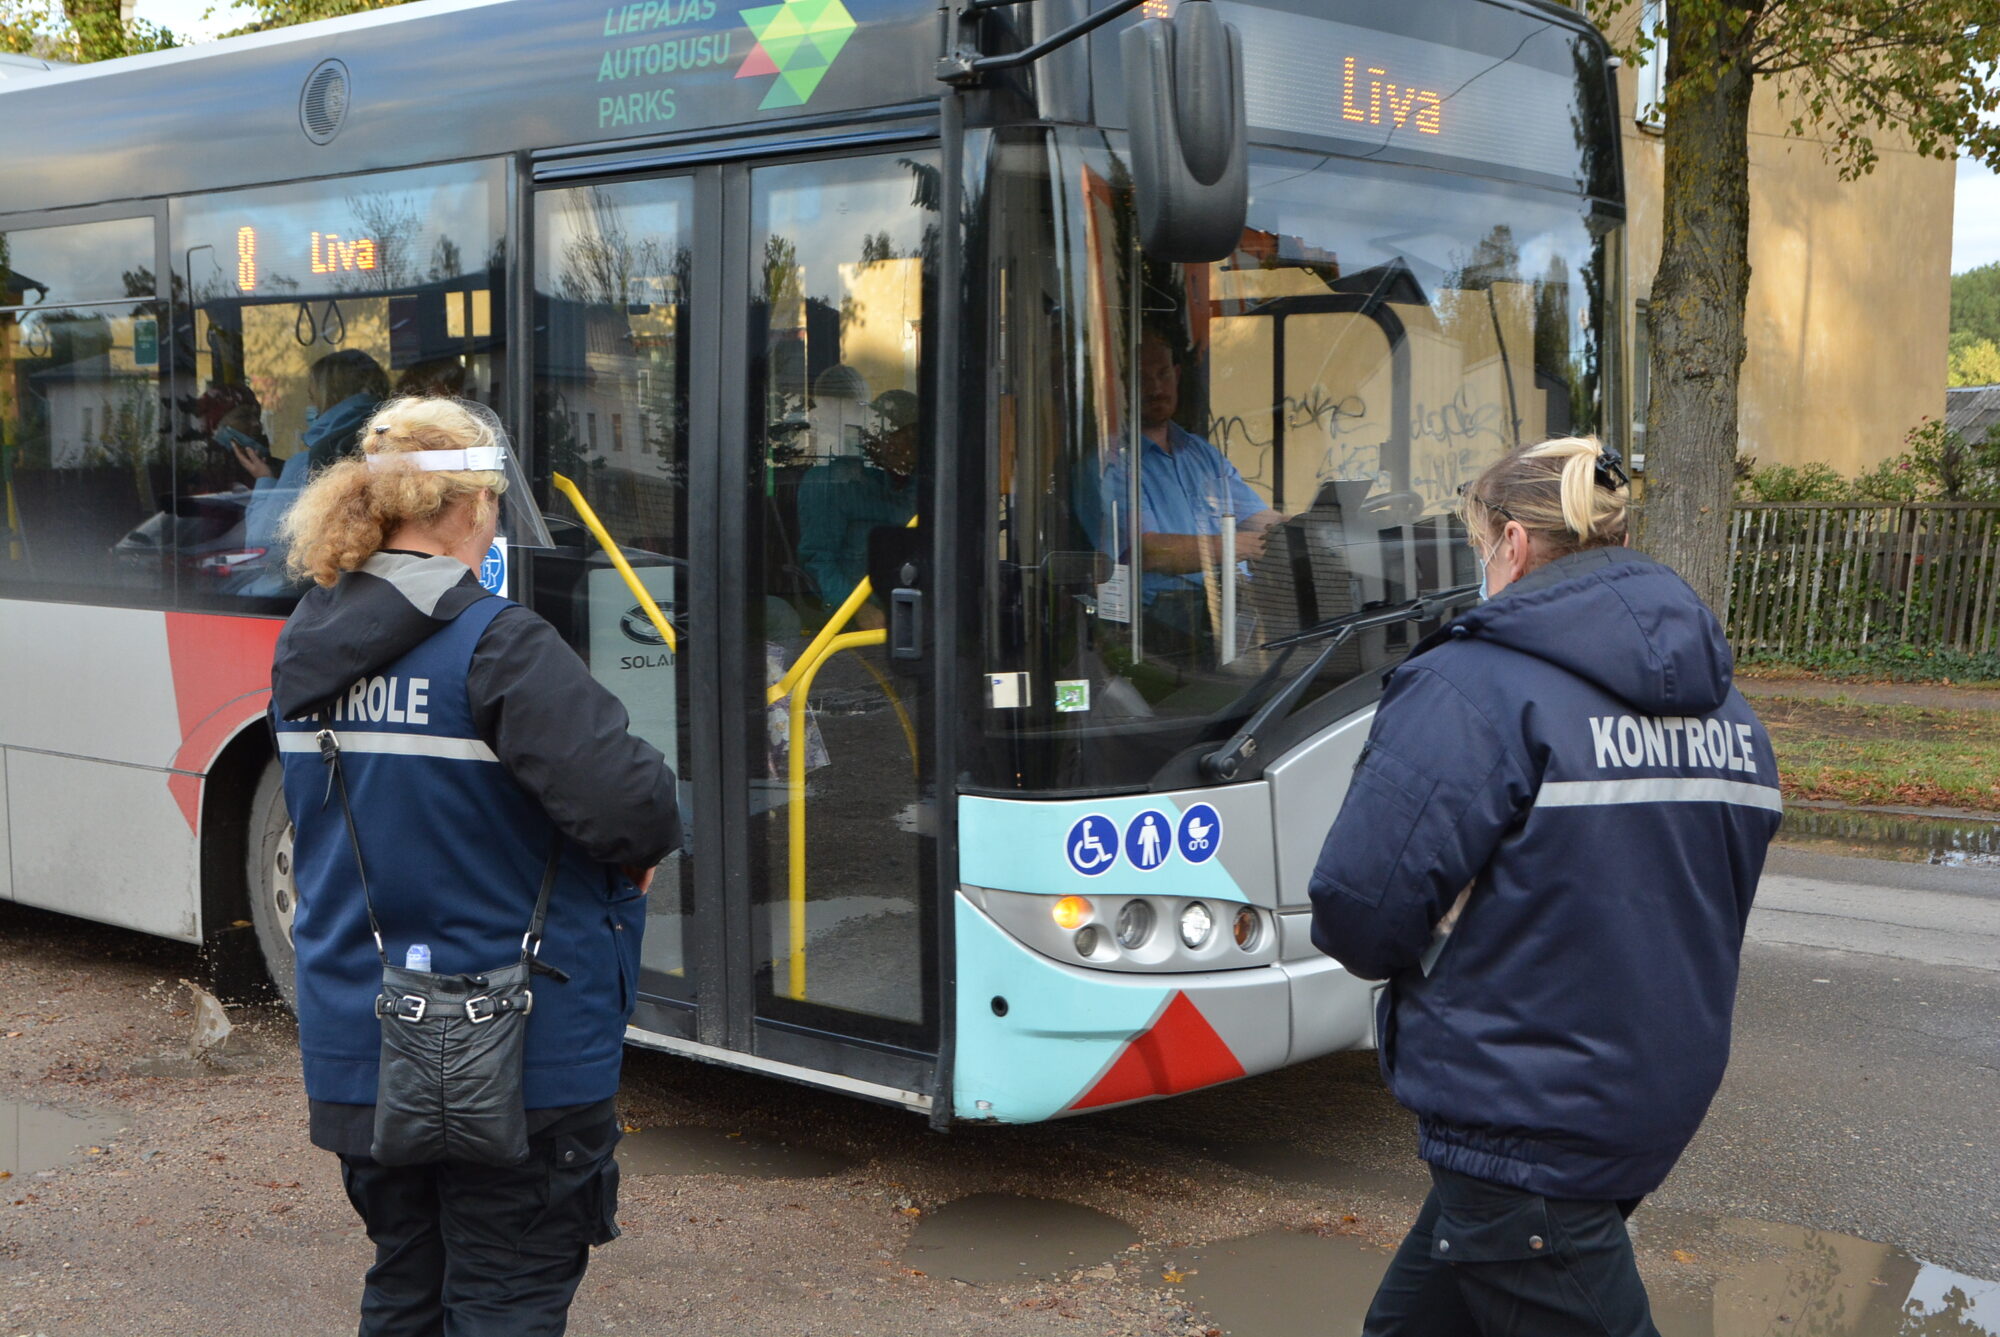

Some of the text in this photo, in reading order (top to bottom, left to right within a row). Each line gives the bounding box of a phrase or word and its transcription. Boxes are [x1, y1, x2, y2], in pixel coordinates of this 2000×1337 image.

[597, 32, 731, 82] AUTOBUSU
[599, 88, 676, 129] PARKS
[1343, 57, 1440, 134] Līva
[238, 226, 375, 291] 8 Līva
[1589, 715, 1757, 774] KONTROLE
